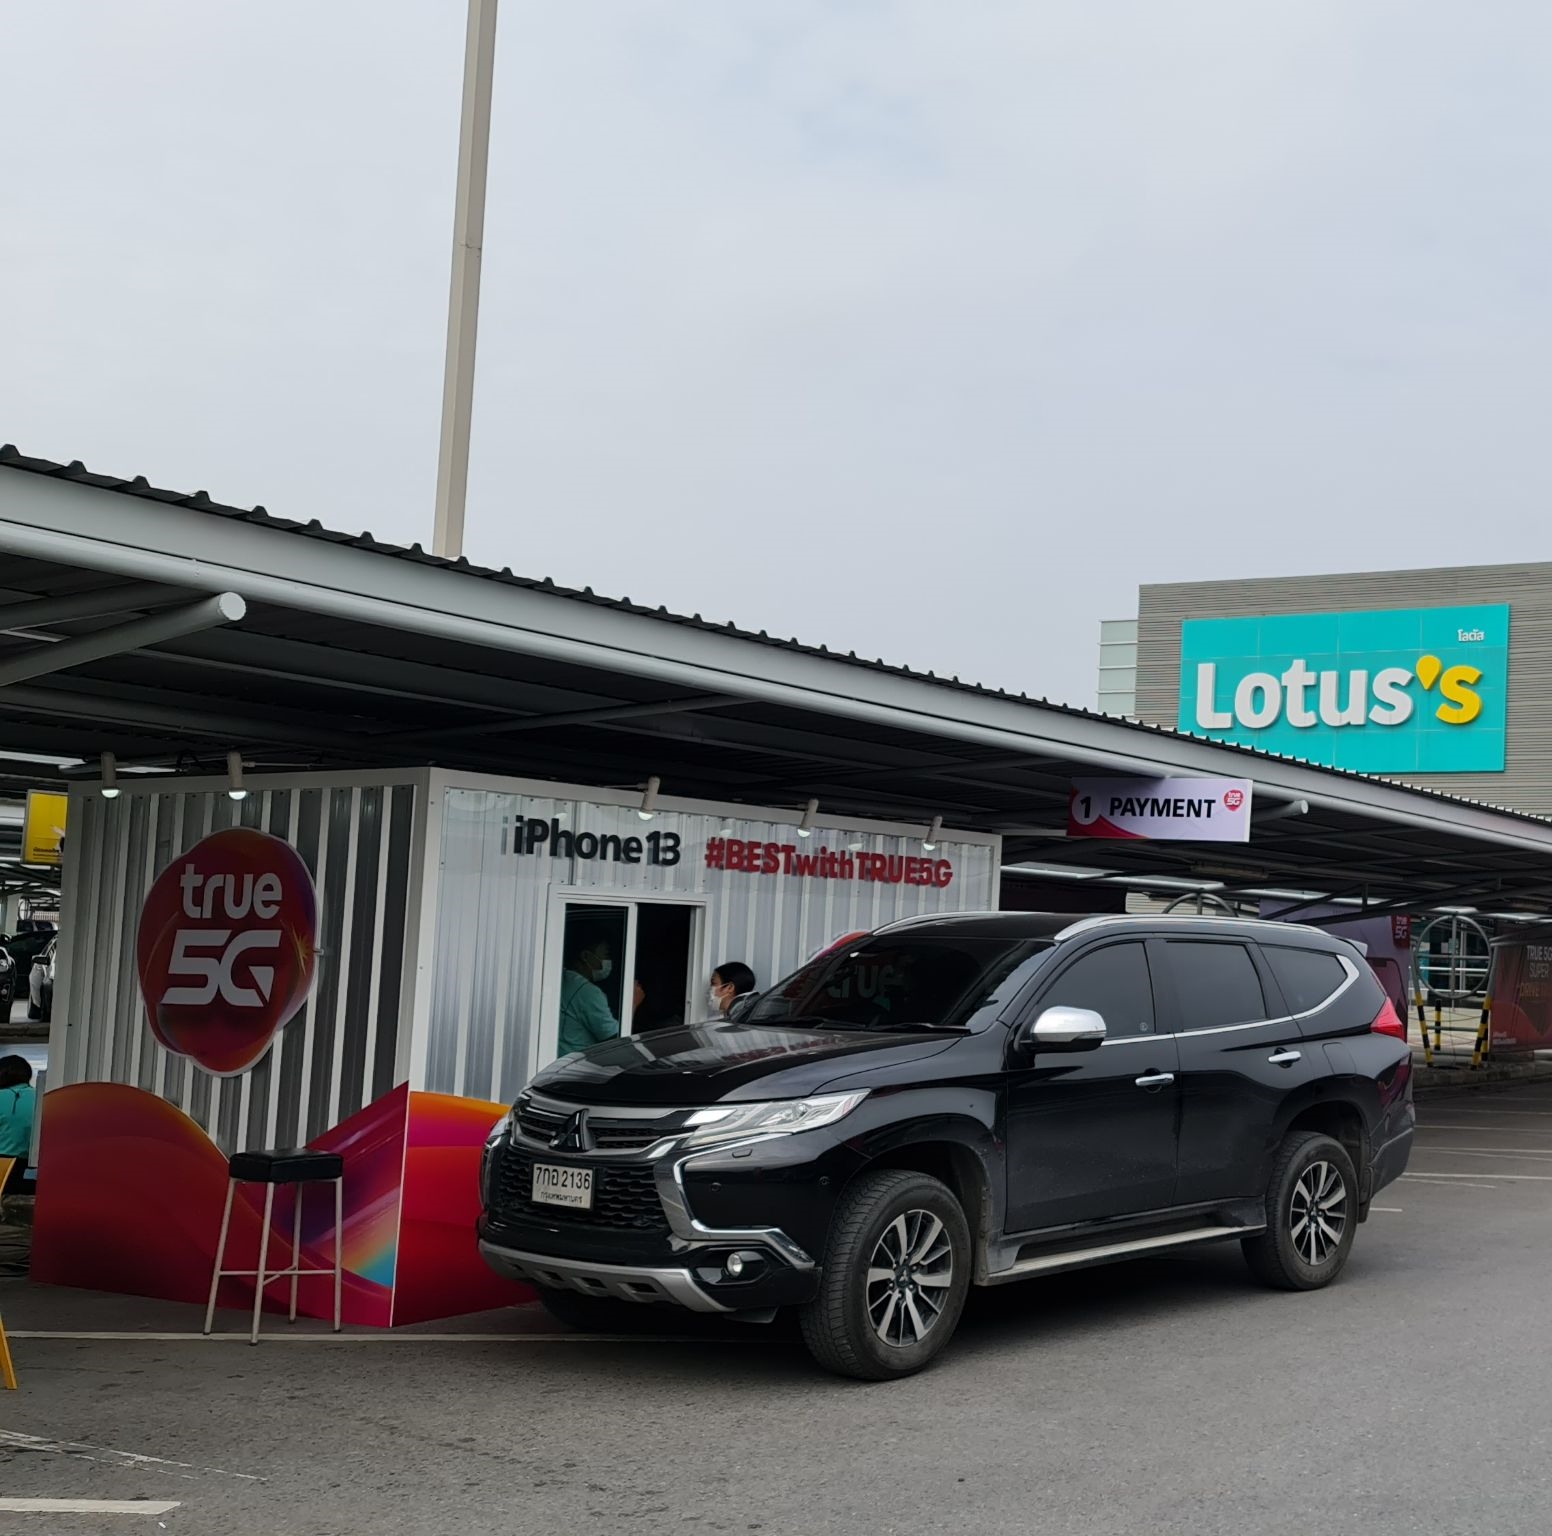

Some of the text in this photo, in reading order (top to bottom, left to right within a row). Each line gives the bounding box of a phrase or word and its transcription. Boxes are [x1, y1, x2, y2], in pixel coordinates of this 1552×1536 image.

[1196, 654, 1484, 729] Lotus's
[1080, 796, 1217, 819] 1 PAYMENT
[703, 836, 955, 889] #BESTwithTRUE5G
[180, 863, 283, 920] true
[159, 929, 282, 1008] 5G
[561, 1169, 591, 1190] 2136
